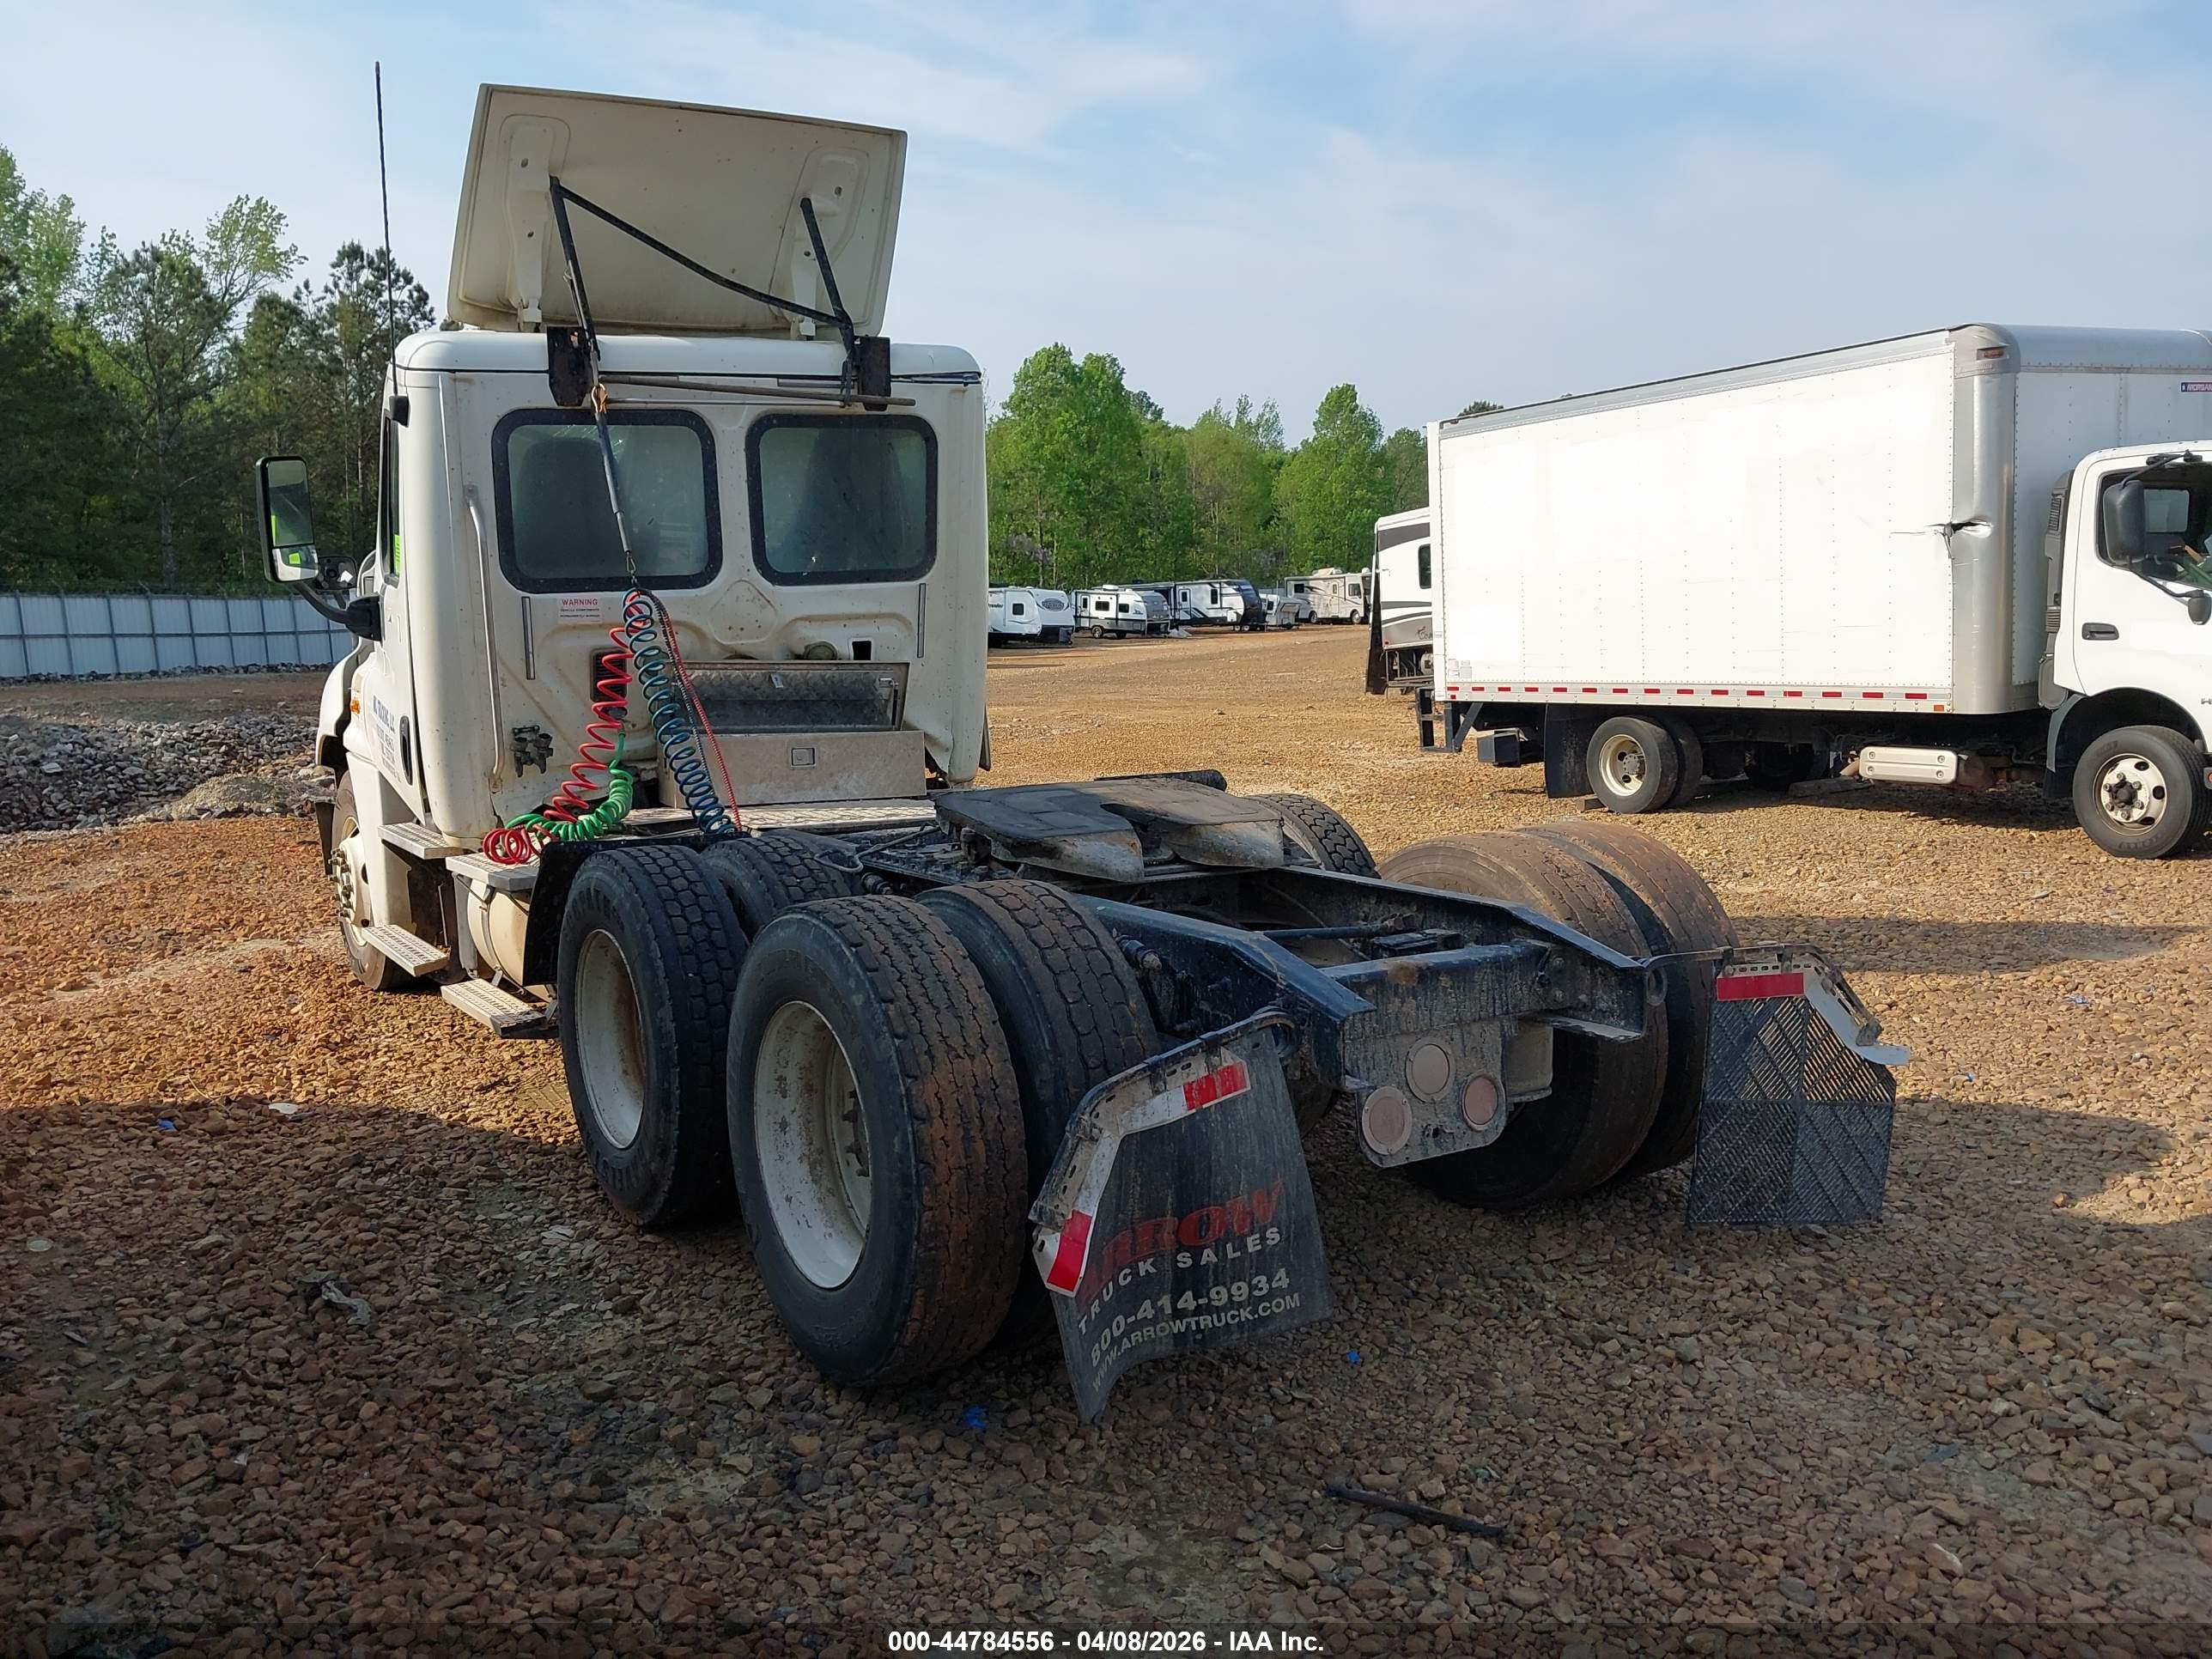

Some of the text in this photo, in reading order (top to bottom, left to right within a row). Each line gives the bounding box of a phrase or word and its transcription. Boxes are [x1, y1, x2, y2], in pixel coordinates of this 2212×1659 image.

[1079, 1226, 1281, 1335] TRUCK SALES
[1091, 1267, 1290, 1368] 800-414-9934
[1092, 1292, 1301, 1392] WWW.ARROWTRUCK.COM
